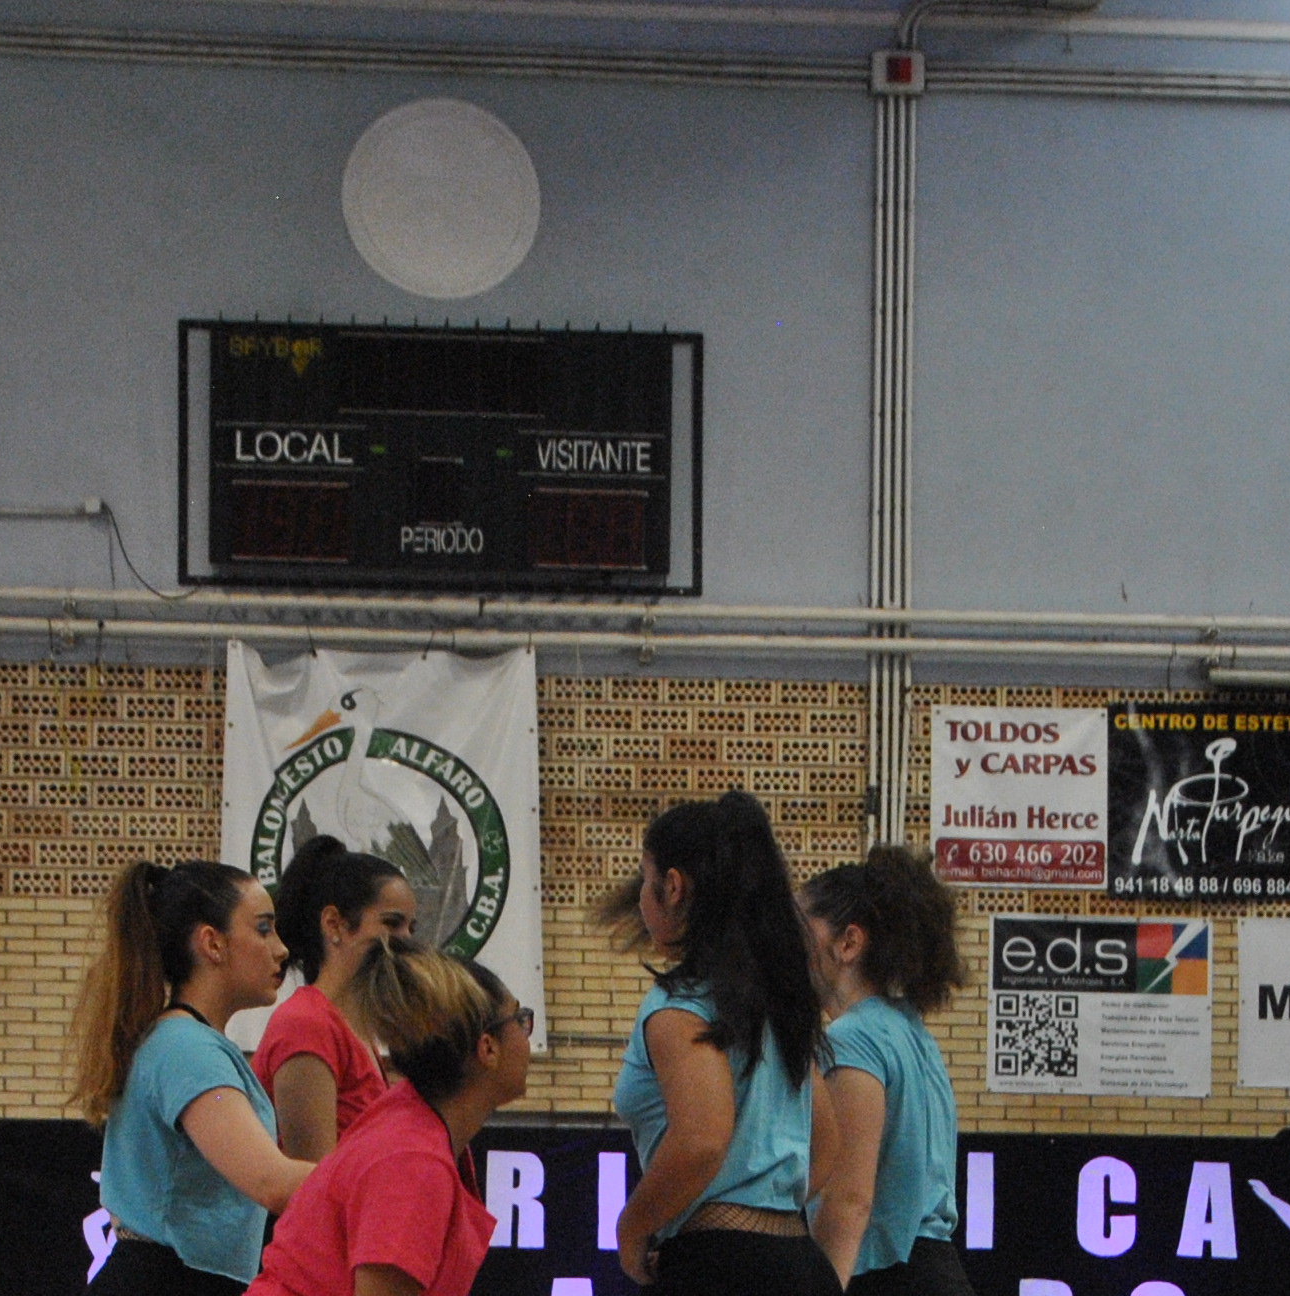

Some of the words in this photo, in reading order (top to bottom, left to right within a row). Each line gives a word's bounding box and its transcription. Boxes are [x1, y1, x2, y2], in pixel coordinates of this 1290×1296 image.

[234, 429, 353, 465] LOCAL
[536, 438, 651, 473] VISITANTE
[400, 525, 483, 553] PERIODO
[945, 720, 1060, 743] TOLDOS
[1114, 714, 1197, 730] CENTRO
[1203, 714, 1228, 730] DE
[390, 736, 485, 809] ALFARO
[954, 757, 971, 778] y
[981, 752, 1097, 776] CARPAS
[942, 803, 1017, 829] Julián
[1027, 806, 1099, 829] Herce
[969, 842, 1007, 864] 630
[1014, 843, 1052, 865] 466
[1060, 844, 1097, 866] 202
[1115, 876, 1143, 893] 941
[1150, 876, 1169, 893] 18
[1174, 877, 1194, 894] 48
[1199, 877, 1218, 893] 88
[1223, 877, 1228, 893] /
[1233, 877, 1261, 894] 696
[466, 866, 504, 940] C.B.A.
